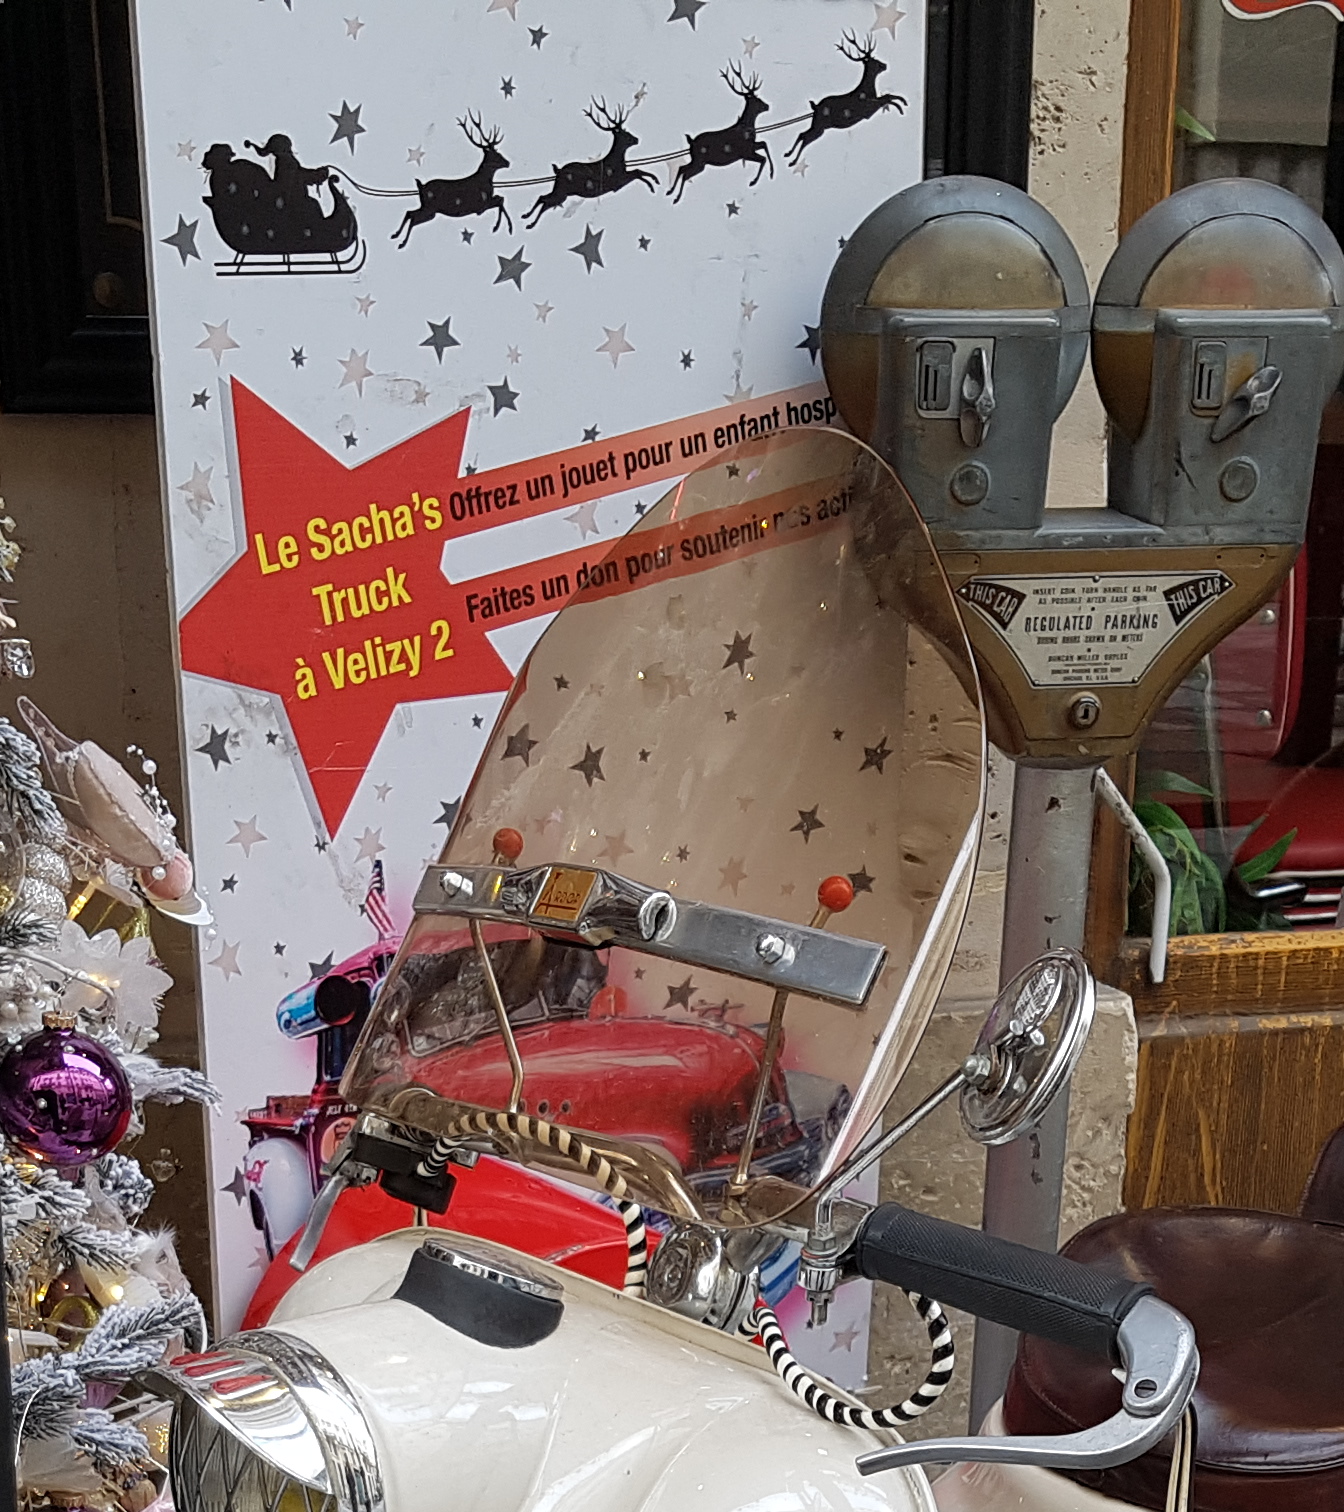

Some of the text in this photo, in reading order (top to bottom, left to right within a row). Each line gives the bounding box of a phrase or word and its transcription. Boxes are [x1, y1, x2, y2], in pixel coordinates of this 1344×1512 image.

[448, 484, 521, 522] Offrez
[526, 474, 555, 502] un
[559, 451, 620, 499] jouet
[624, 443, 673, 482] pour
[679, 432, 708, 459] un
[712, 407, 782, 454] enfant
[254, 492, 443, 576] Le Sacha's
[313, 567, 412, 626] Truck
[465, 581, 535, 622] Faites
[540, 571, 570, 600] un
[574, 559, 620, 592] don
[626, 544, 674, 585] pour
[680, 521, 768, 563] soutenir
[969, 583, 1018, 620] THIS CAR
[1171, 577, 1221, 616] THIS CAR
[1025, 613, 1159, 633] REGULATED PARKING
[294, 619, 454, 700] à Velizy 2
